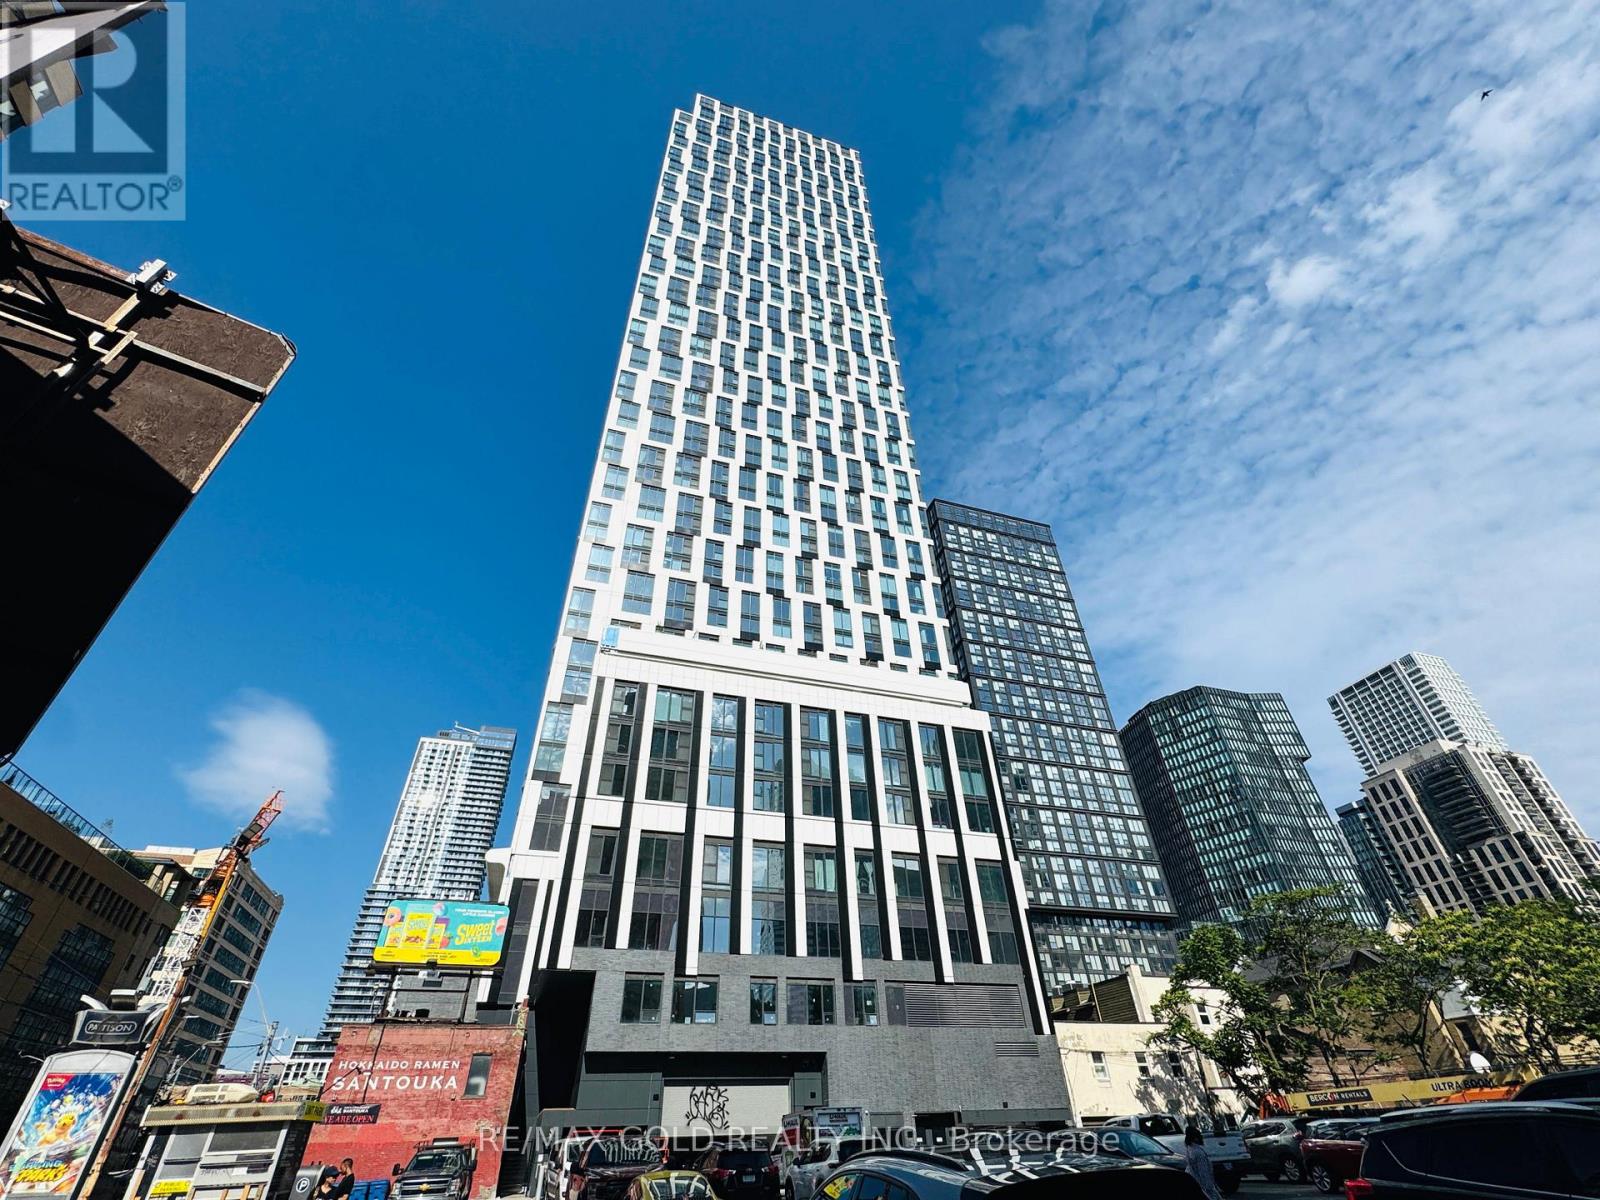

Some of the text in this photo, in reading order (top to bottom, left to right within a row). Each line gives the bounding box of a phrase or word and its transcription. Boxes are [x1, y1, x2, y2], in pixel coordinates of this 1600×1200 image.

[88, 1023, 132, 1032] PATISON
[338, 1060, 460, 1070] HOKKAIDO RAMEN
[331, 1075, 458, 1091] SANTOUKA
[1431, 1076, 1495, 1092] ULTRA BOOM
[1341, 1090, 1369, 1099] RENTALS
[335, 1115, 351, 1124] ARE
[352, 1115, 375, 1123] OPEN
